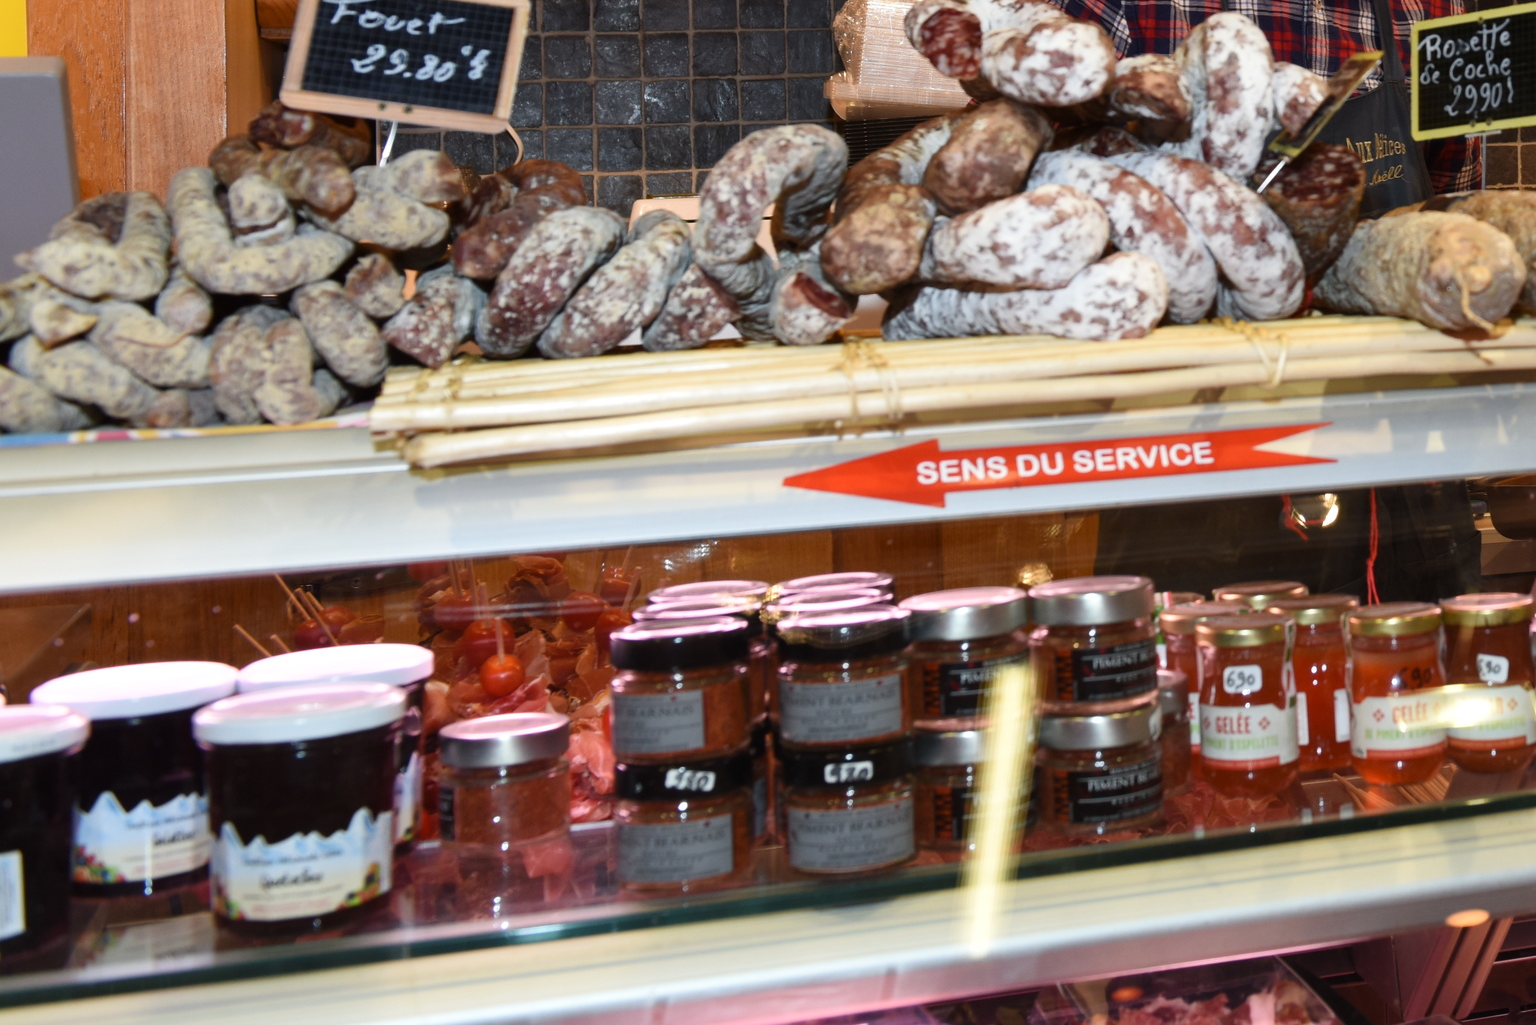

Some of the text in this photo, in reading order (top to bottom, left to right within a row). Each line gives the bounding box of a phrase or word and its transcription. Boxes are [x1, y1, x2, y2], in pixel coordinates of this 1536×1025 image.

[1420, 64, 1440, 85] de
[914, 440, 1215, 487] SENS DU SERVICE
[1214, 711, 1252, 734] GELÉE
[1391, 700, 1429, 723] GELÉE
